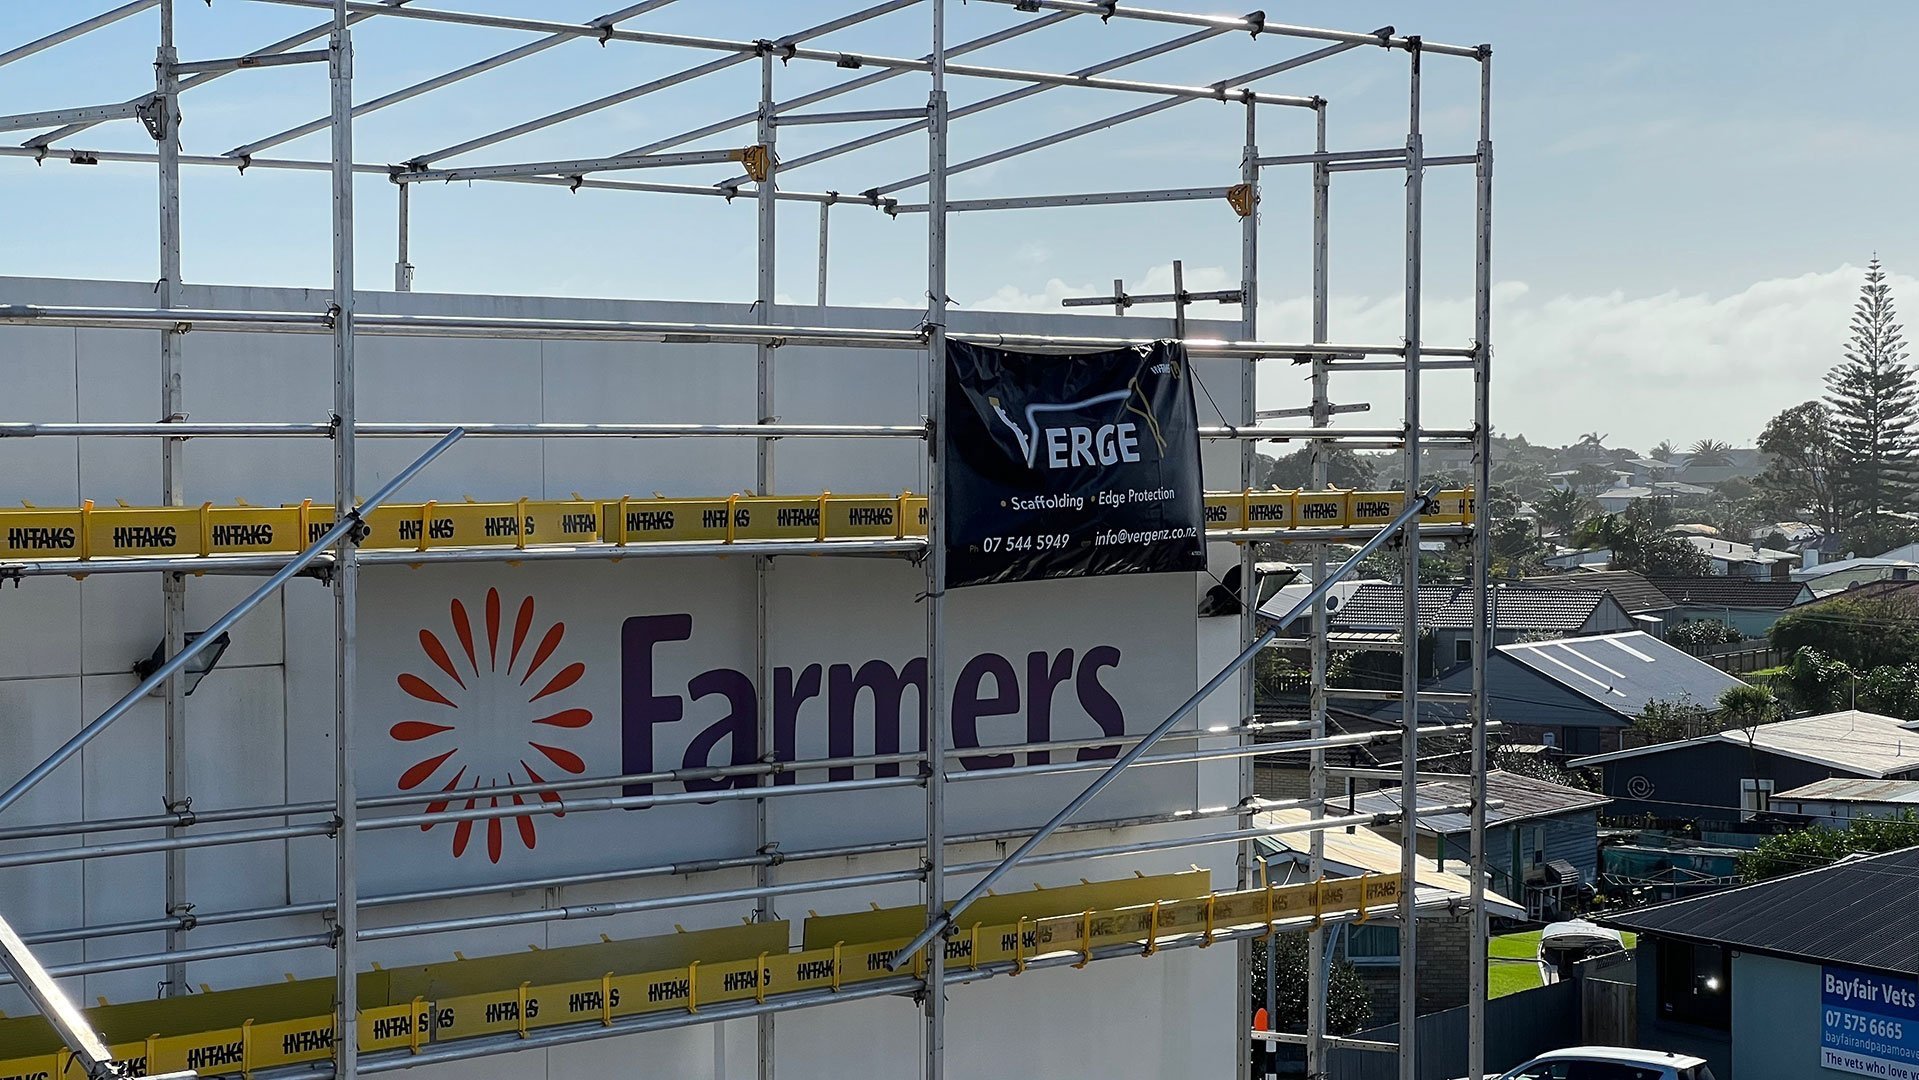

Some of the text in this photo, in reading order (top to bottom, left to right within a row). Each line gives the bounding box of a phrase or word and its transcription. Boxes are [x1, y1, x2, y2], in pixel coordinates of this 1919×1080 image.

[988, 396, 1141, 469] VERGE
[1011, 493, 1084, 511] Scaffolding
[1098, 486, 1175, 508] Edge Protection
[627, 511, 674, 531] INTAKS
[849, 507, 893, 525] INTAKS
[1248, 504, 1283, 521] INTAKS
[1303, 503, 1337, 519] INTAKS
[1357, 502, 1389, 518] INTAKS
[113, 526, 176, 548] INTAKS
[212, 524, 273, 546] INTAKS
[485, 516, 534, 537] INTAS
[1095, 526, 1197, 546] info@vergenz.co.nz
[8, 527, 75, 549] INTAKS
[983, 537, 1002, 553] 07
[1005, 536, 1032, 552] 544
[1036, 533, 1070, 551] 5949
[621, 614, 1125, 810] Farmers
[569, 988, 620, 1013] INTAS
[1825, 973, 1916, 1008] Bayfair Vets
[1826, 1010, 1903, 1040] 07 575 6665
[1825, 1051, 1842, 1066] The
[1844, 1057, 1864, 1070] vets
[1866, 1061, 1886, 1076] who
[1889, 1064, 1908, 1079] love
